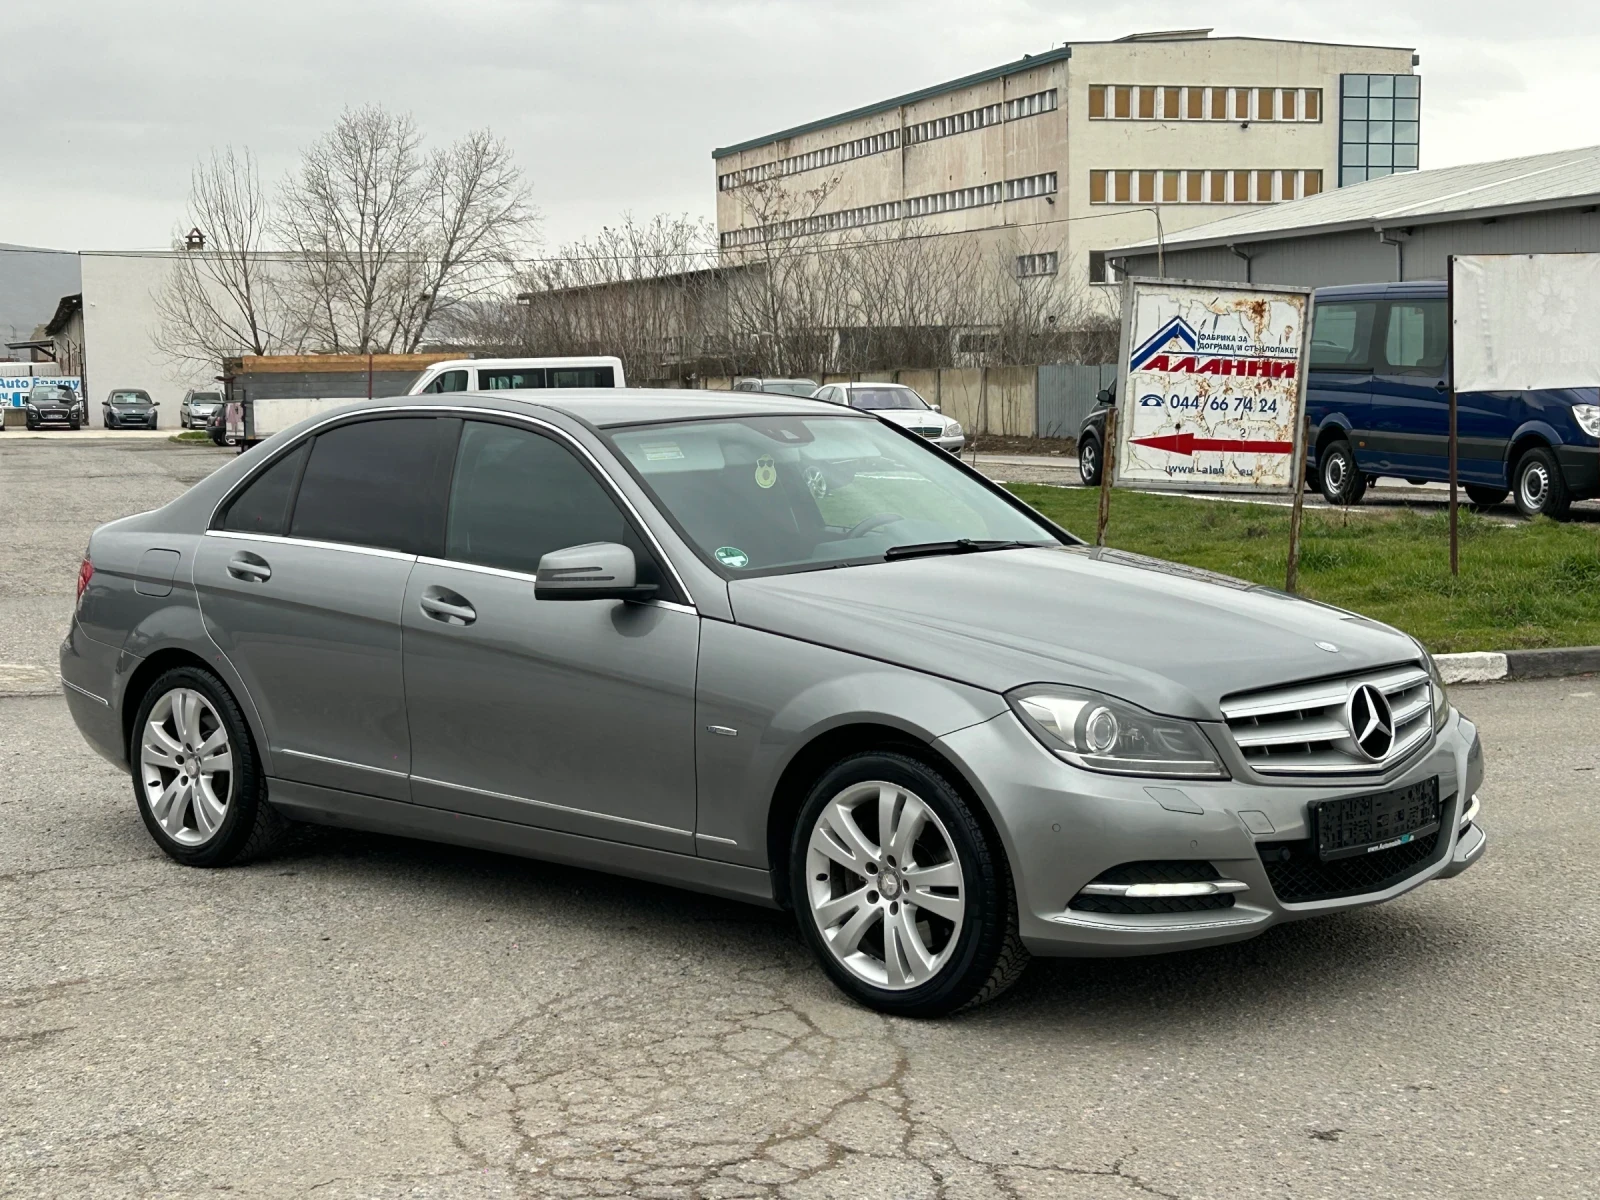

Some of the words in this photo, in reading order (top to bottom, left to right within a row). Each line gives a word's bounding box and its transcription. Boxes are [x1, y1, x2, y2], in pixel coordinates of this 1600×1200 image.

[1200, 333, 1236, 342] ФАБРИКА
[1238, 335, 1248, 344] ЗА
[1200, 342, 1235, 351] ДОГРАМА
[1142, 355, 1295, 378] АЛАННИ
[0, 377, 29, 389] Auto
[1234, 396, 1253, 412] 74
[1258, 398, 1277, 413] 24
